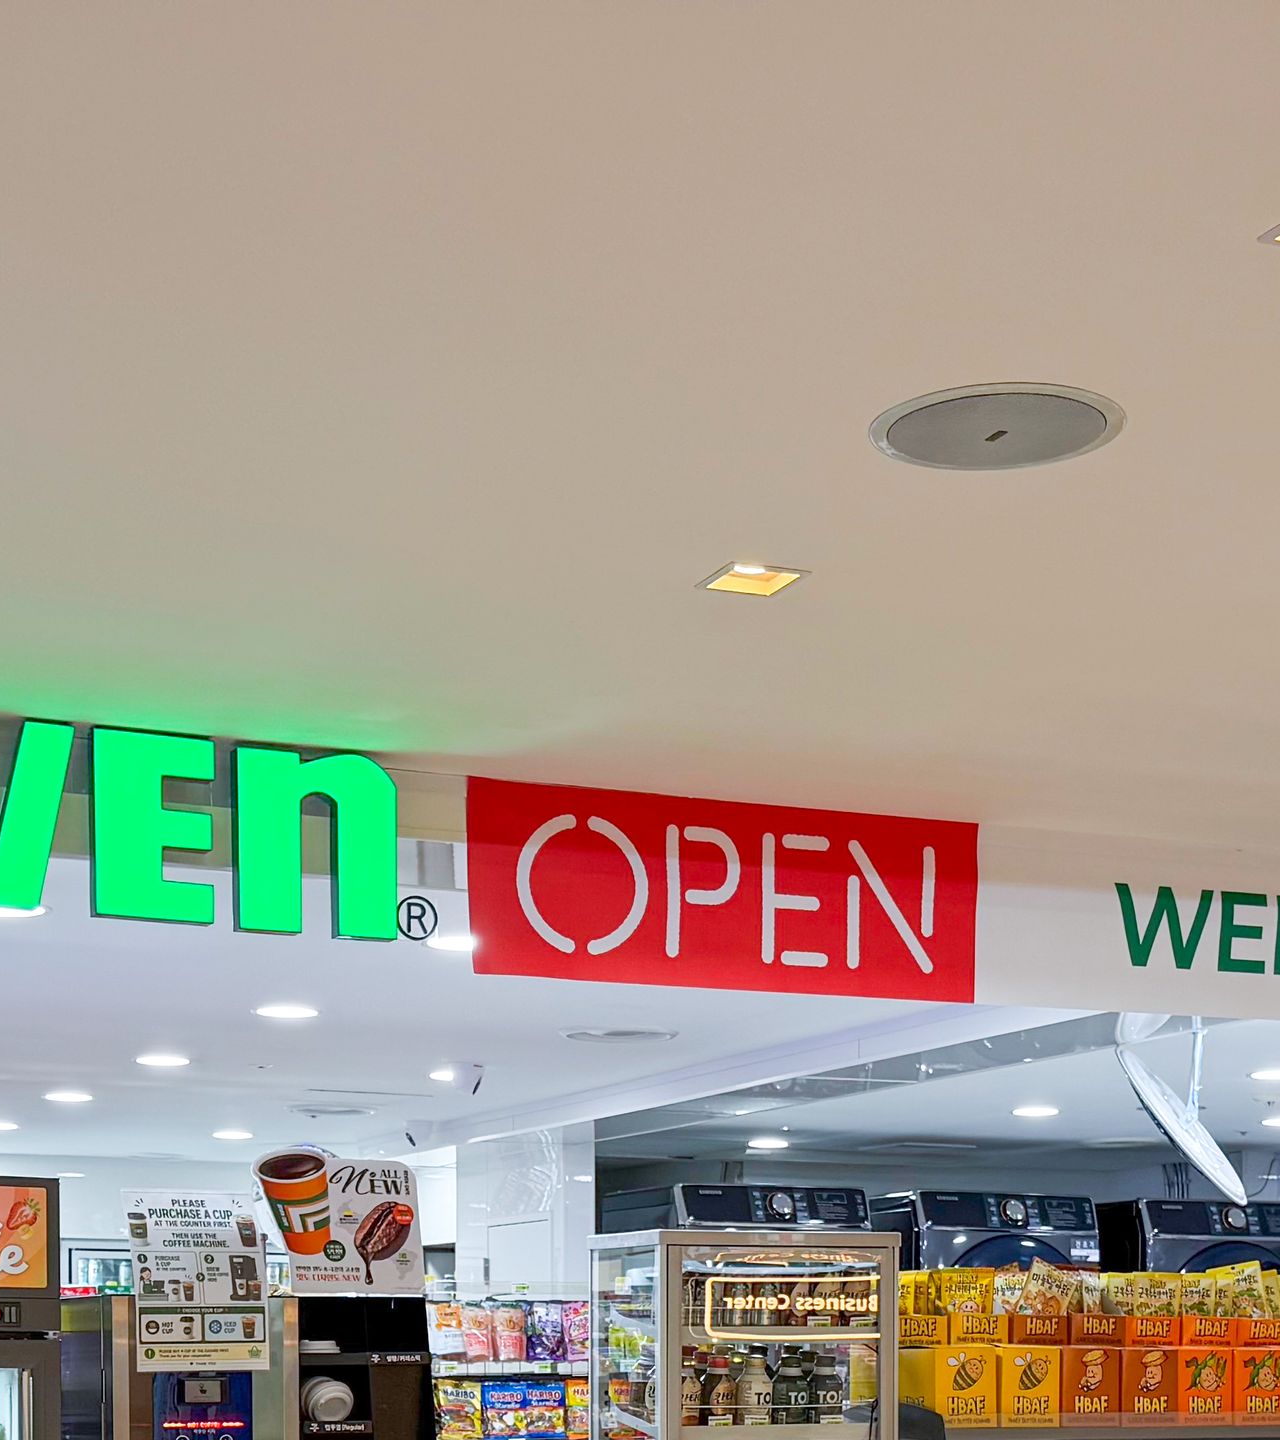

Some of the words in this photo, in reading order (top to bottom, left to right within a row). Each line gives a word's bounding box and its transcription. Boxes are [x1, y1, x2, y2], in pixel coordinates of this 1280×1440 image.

[516, 813, 935, 974] OPEN
[380, 1170, 401, 1179] ALL
[171, 1199, 206, 1208] PLEASE
[148, 1209, 201, 1220] PURCHASE
[204, 1210, 211, 1219] A
[213, 1209, 233, 1220] CUP
[193, 1240, 230, 1248] MACHINE.
[901, 1318, 937, 1337] HBAF
[1026, 1318, 1058, 1336] HBAF
[1196, 1319, 1228, 1337] HBAF
[443, 1390, 475, 1400] HARIBO
[490, 1392, 523, 1402] HARIBO
[527, 1390, 561, 1401] HARIBO
[947, 1396, 985, 1415] HBAF
[1074, 1396, 1108, 1414] HBAF
[1247, 1396, 1279, 1414] HBAF
